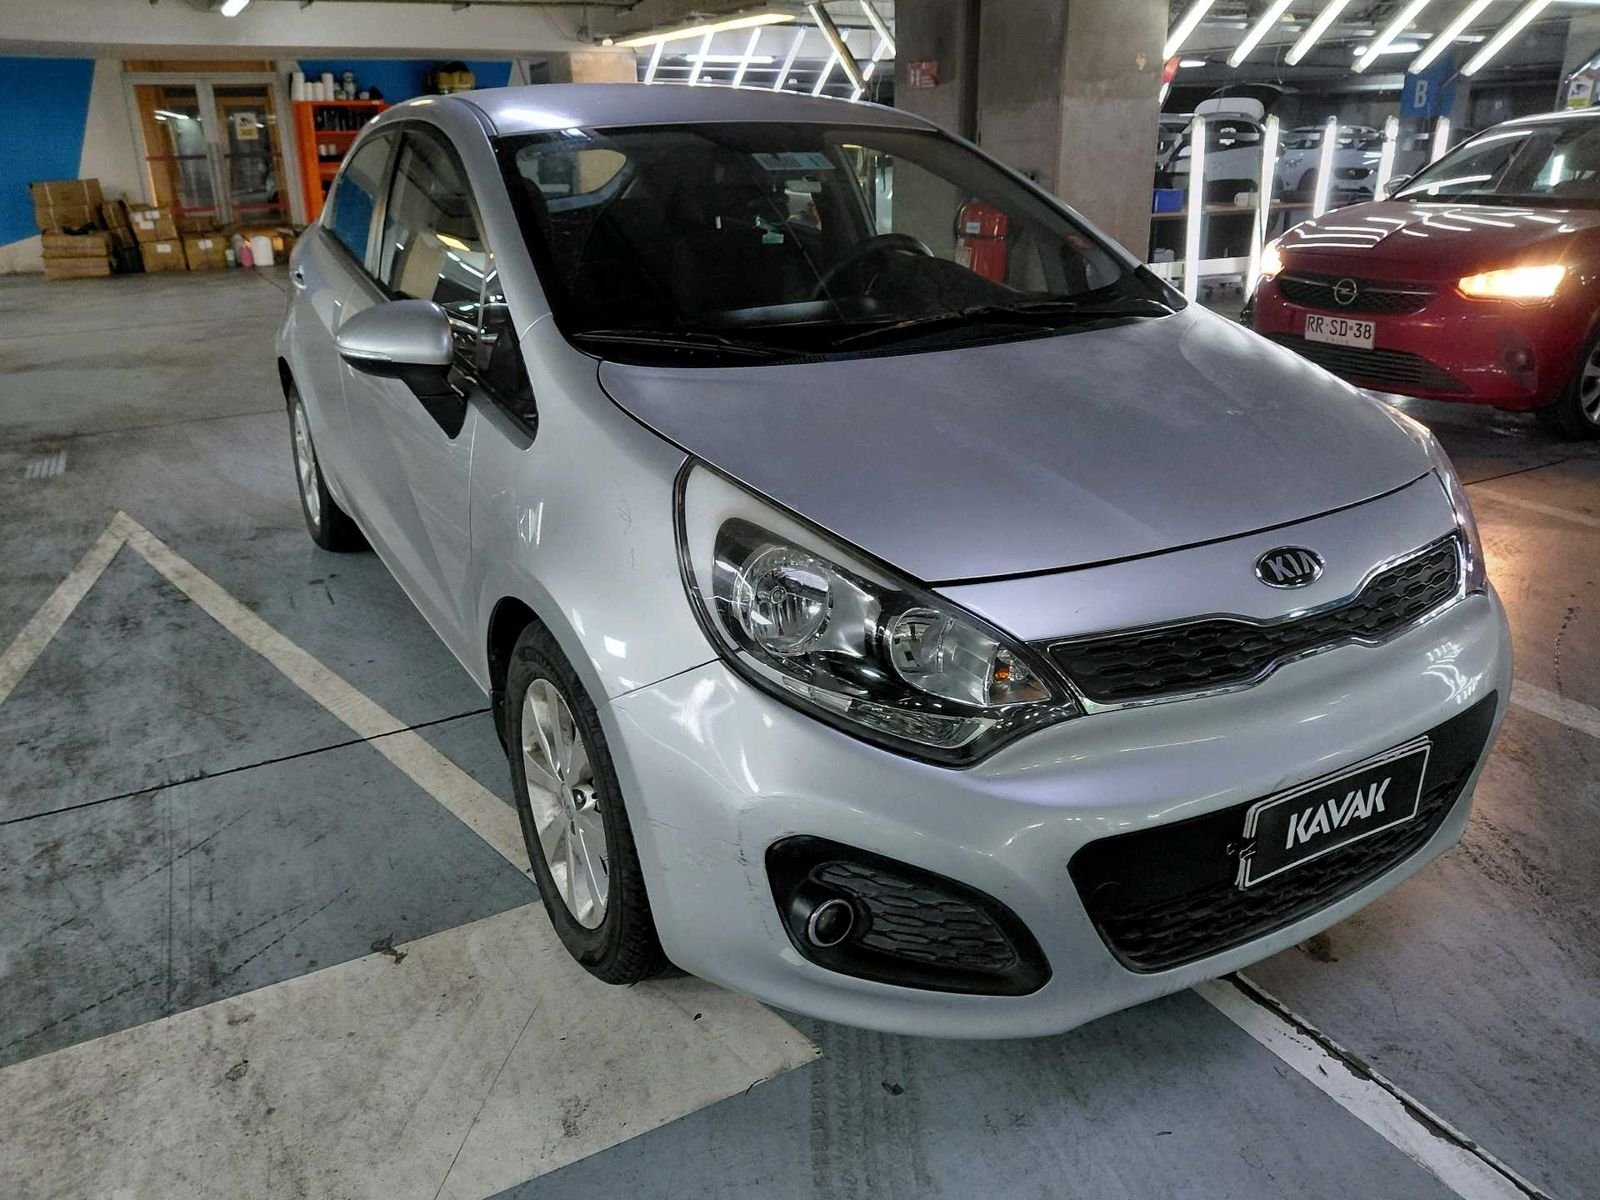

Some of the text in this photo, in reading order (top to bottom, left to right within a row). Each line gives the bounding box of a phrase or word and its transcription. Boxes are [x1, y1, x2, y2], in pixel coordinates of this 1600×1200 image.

[1414, 80, 1428, 108] B
[1265, 550, 1320, 581] KIA
[1285, 777, 1392, 850] KAVAK
